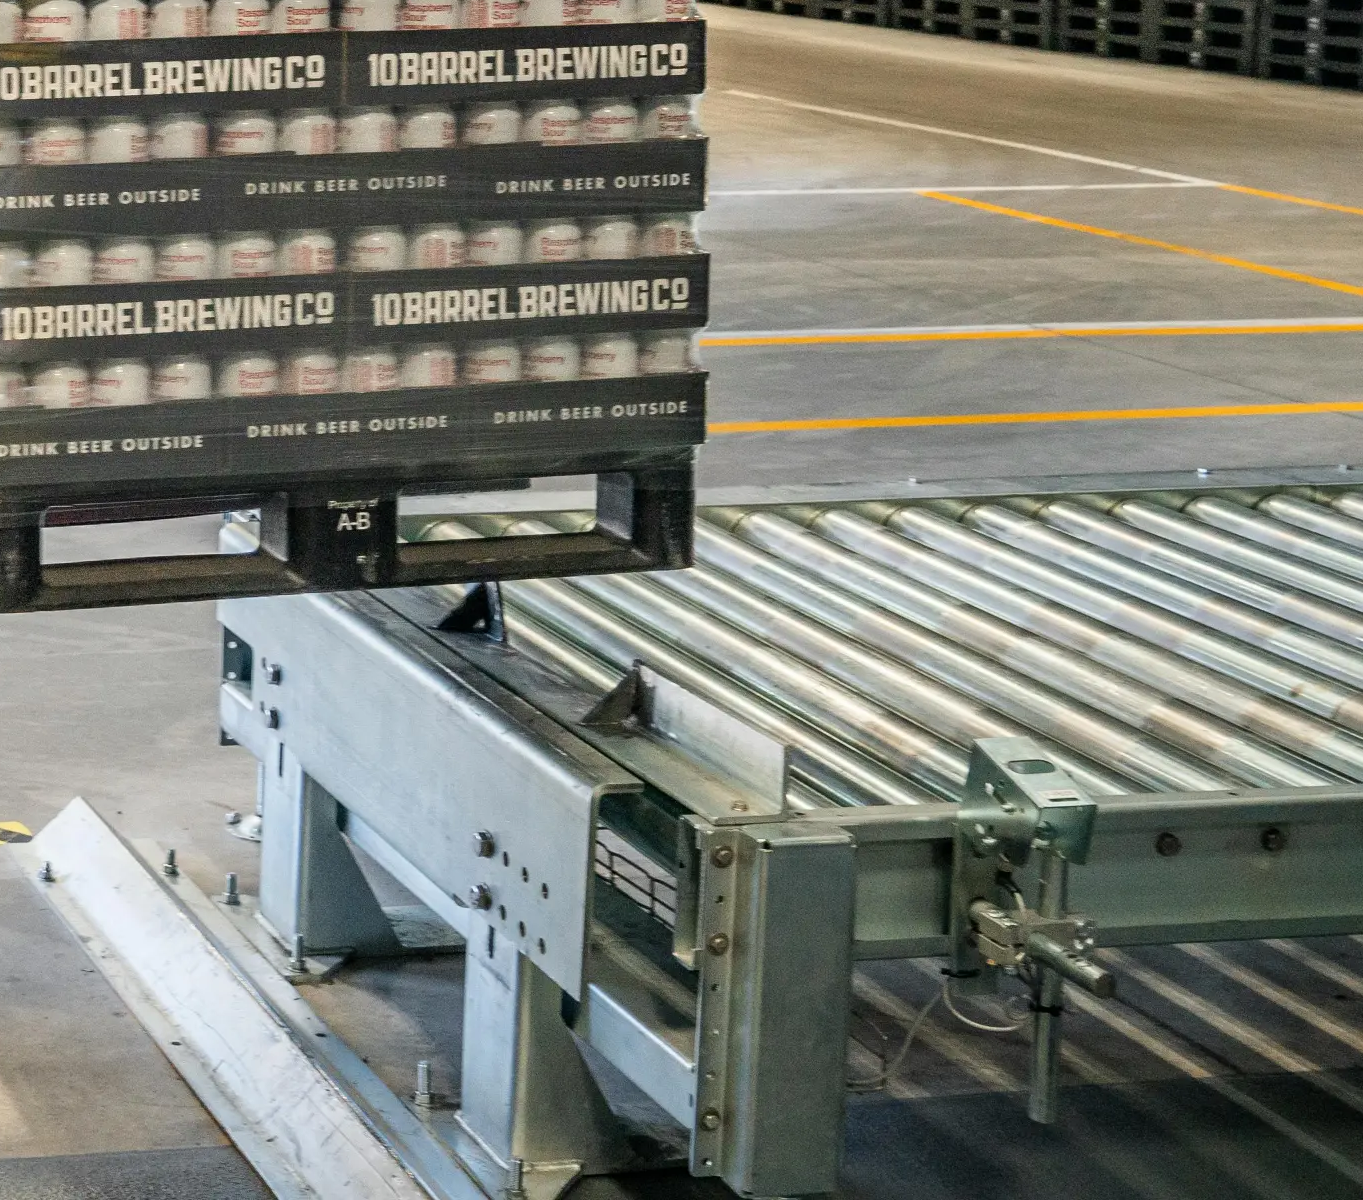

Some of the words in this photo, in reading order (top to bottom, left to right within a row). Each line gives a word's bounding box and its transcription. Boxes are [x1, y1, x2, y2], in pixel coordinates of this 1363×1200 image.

[245, 180, 305, 196] DRINK
[314, 178, 359, 193] BEER
[367, 174, 446, 191] OUTSIDE
[495, 179, 554, 194] DRINK
[562, 176, 605, 191] BEER
[613, 172, 690, 189] OUTSIDE
[63, 192, 109, 207] BEER
[118, 188, 200, 205] OUTSIDE
[493, 408, 552, 425] DRINK
[559, 405, 603, 421] BEER
[610, 400, 687, 418] OUTSIDE
[247, 423, 307, 438] DRINK
[315, 420, 360, 435] BEER
[368, 415, 448, 432] OUTSIDE
[67, 439, 113, 455] BEER
[121, 434, 203, 452] OUTSIDE
[337, 511, 371, 532] A-B
